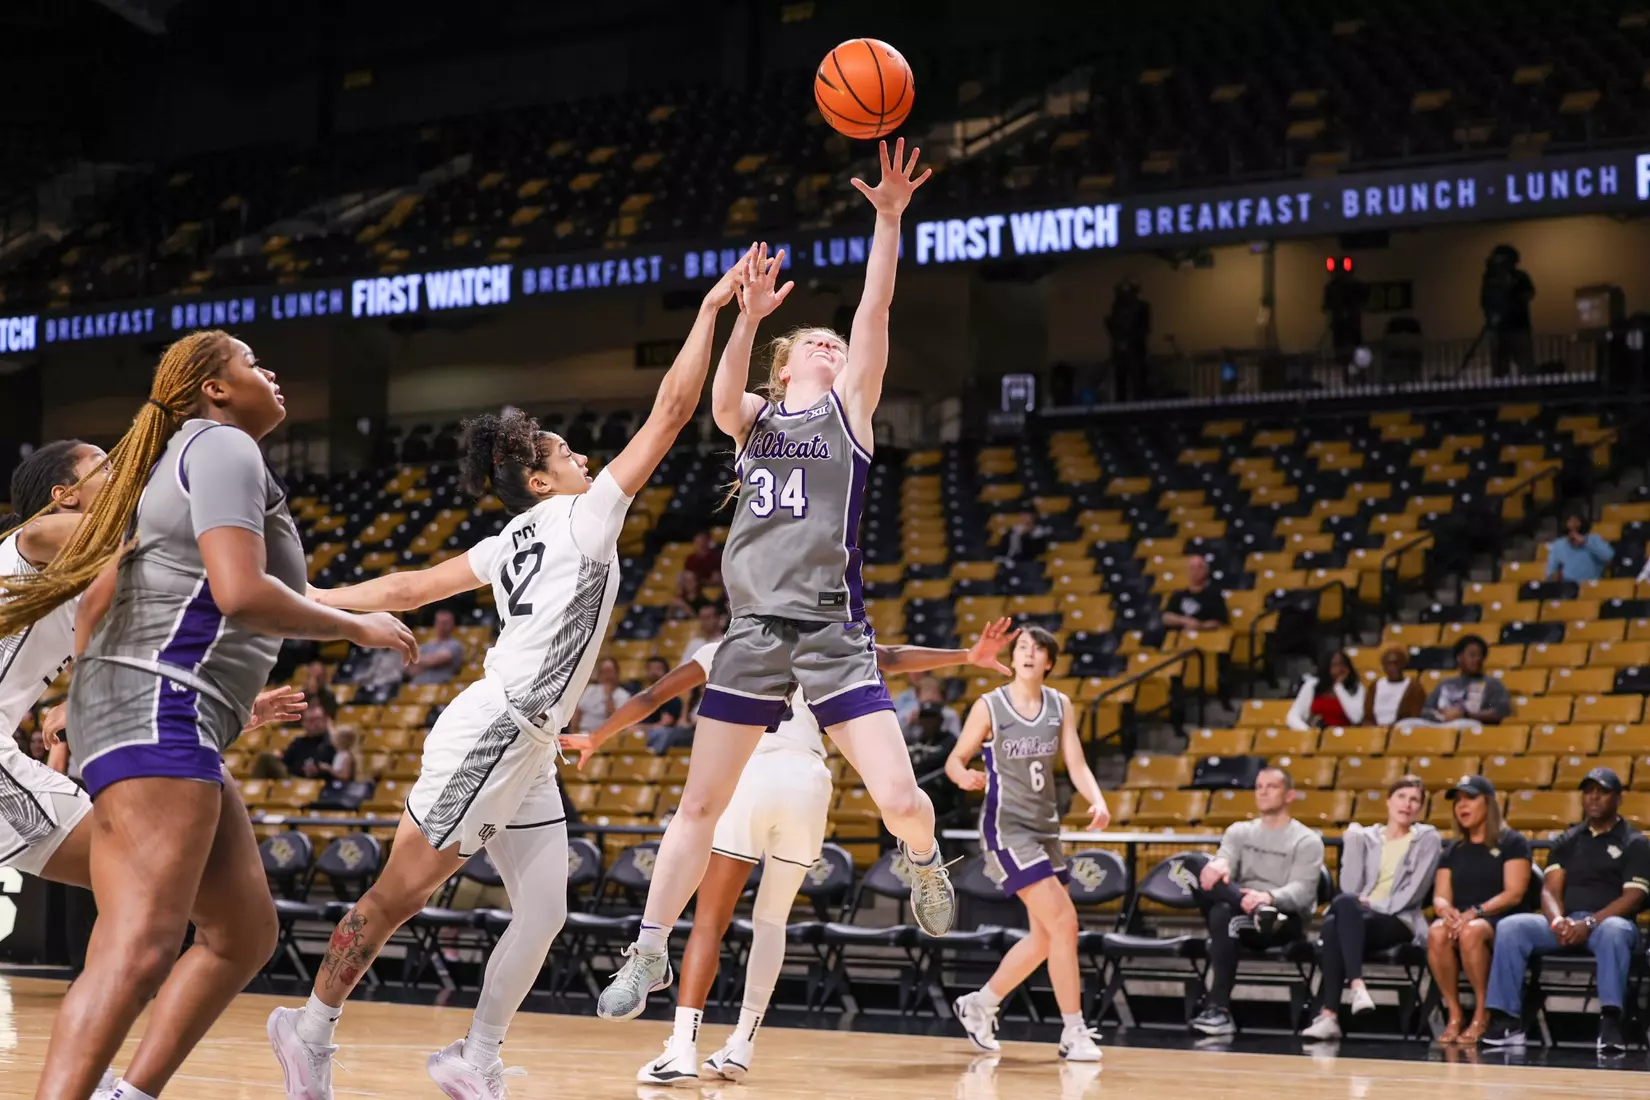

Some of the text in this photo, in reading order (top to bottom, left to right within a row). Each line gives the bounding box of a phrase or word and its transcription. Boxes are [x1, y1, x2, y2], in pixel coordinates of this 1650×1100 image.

[45, 309, 155, 342] BREAKFAST
[171, 298, 255, 329] BRUNCH
[271, 289, 343, 320] LUNCH
[351, 274, 422, 318] FIRST
[425, 264, 511, 310] WATCH
[522, 255, 662, 295] BREAKFAST
[694, 243, 792, 280] BRUH
[813, 231, 904, 267] LUN
[916, 215, 1004, 265] FIRST
[1009, 203, 1120, 255] WATCH
[1135, 193, 1312, 237] BREAKFAST
[1342, 179, 1476, 219] BRUNCH
[1506, 165, 1619, 203] LUNCH
[749, 467, 808, 519] 34
[1028, 760, 1046, 793] 6
